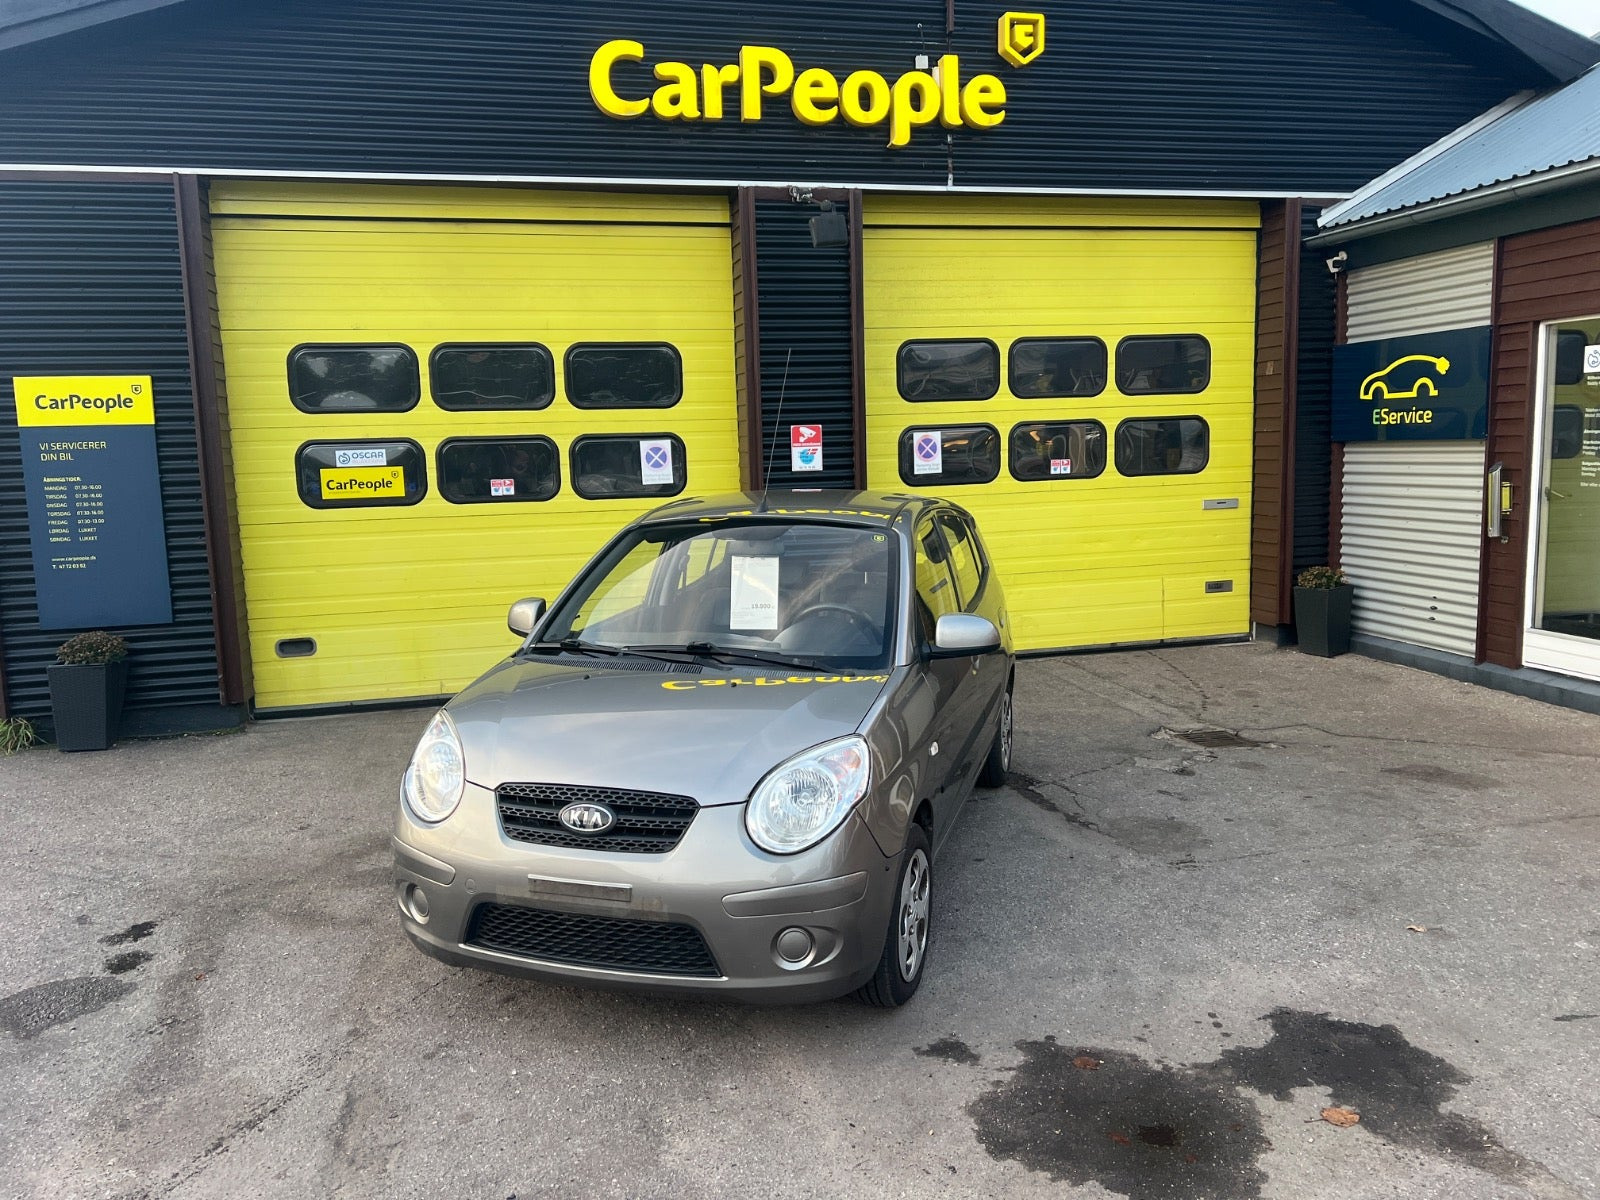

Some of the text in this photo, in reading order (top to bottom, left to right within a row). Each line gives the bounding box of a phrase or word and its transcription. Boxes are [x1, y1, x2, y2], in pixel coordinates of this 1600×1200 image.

[589, 39, 1007, 149] CarPeople
[34, 393, 134, 413] CarPeople
[1372, 406, 1433, 426] EService
[50, 441, 107, 450] SERVICERER
[40, 452, 74, 462] DIN BIL
[351, 451, 384, 459] OSCAR
[326, 478, 393, 492] CarPeople
[570, 809, 602, 826] KIA
